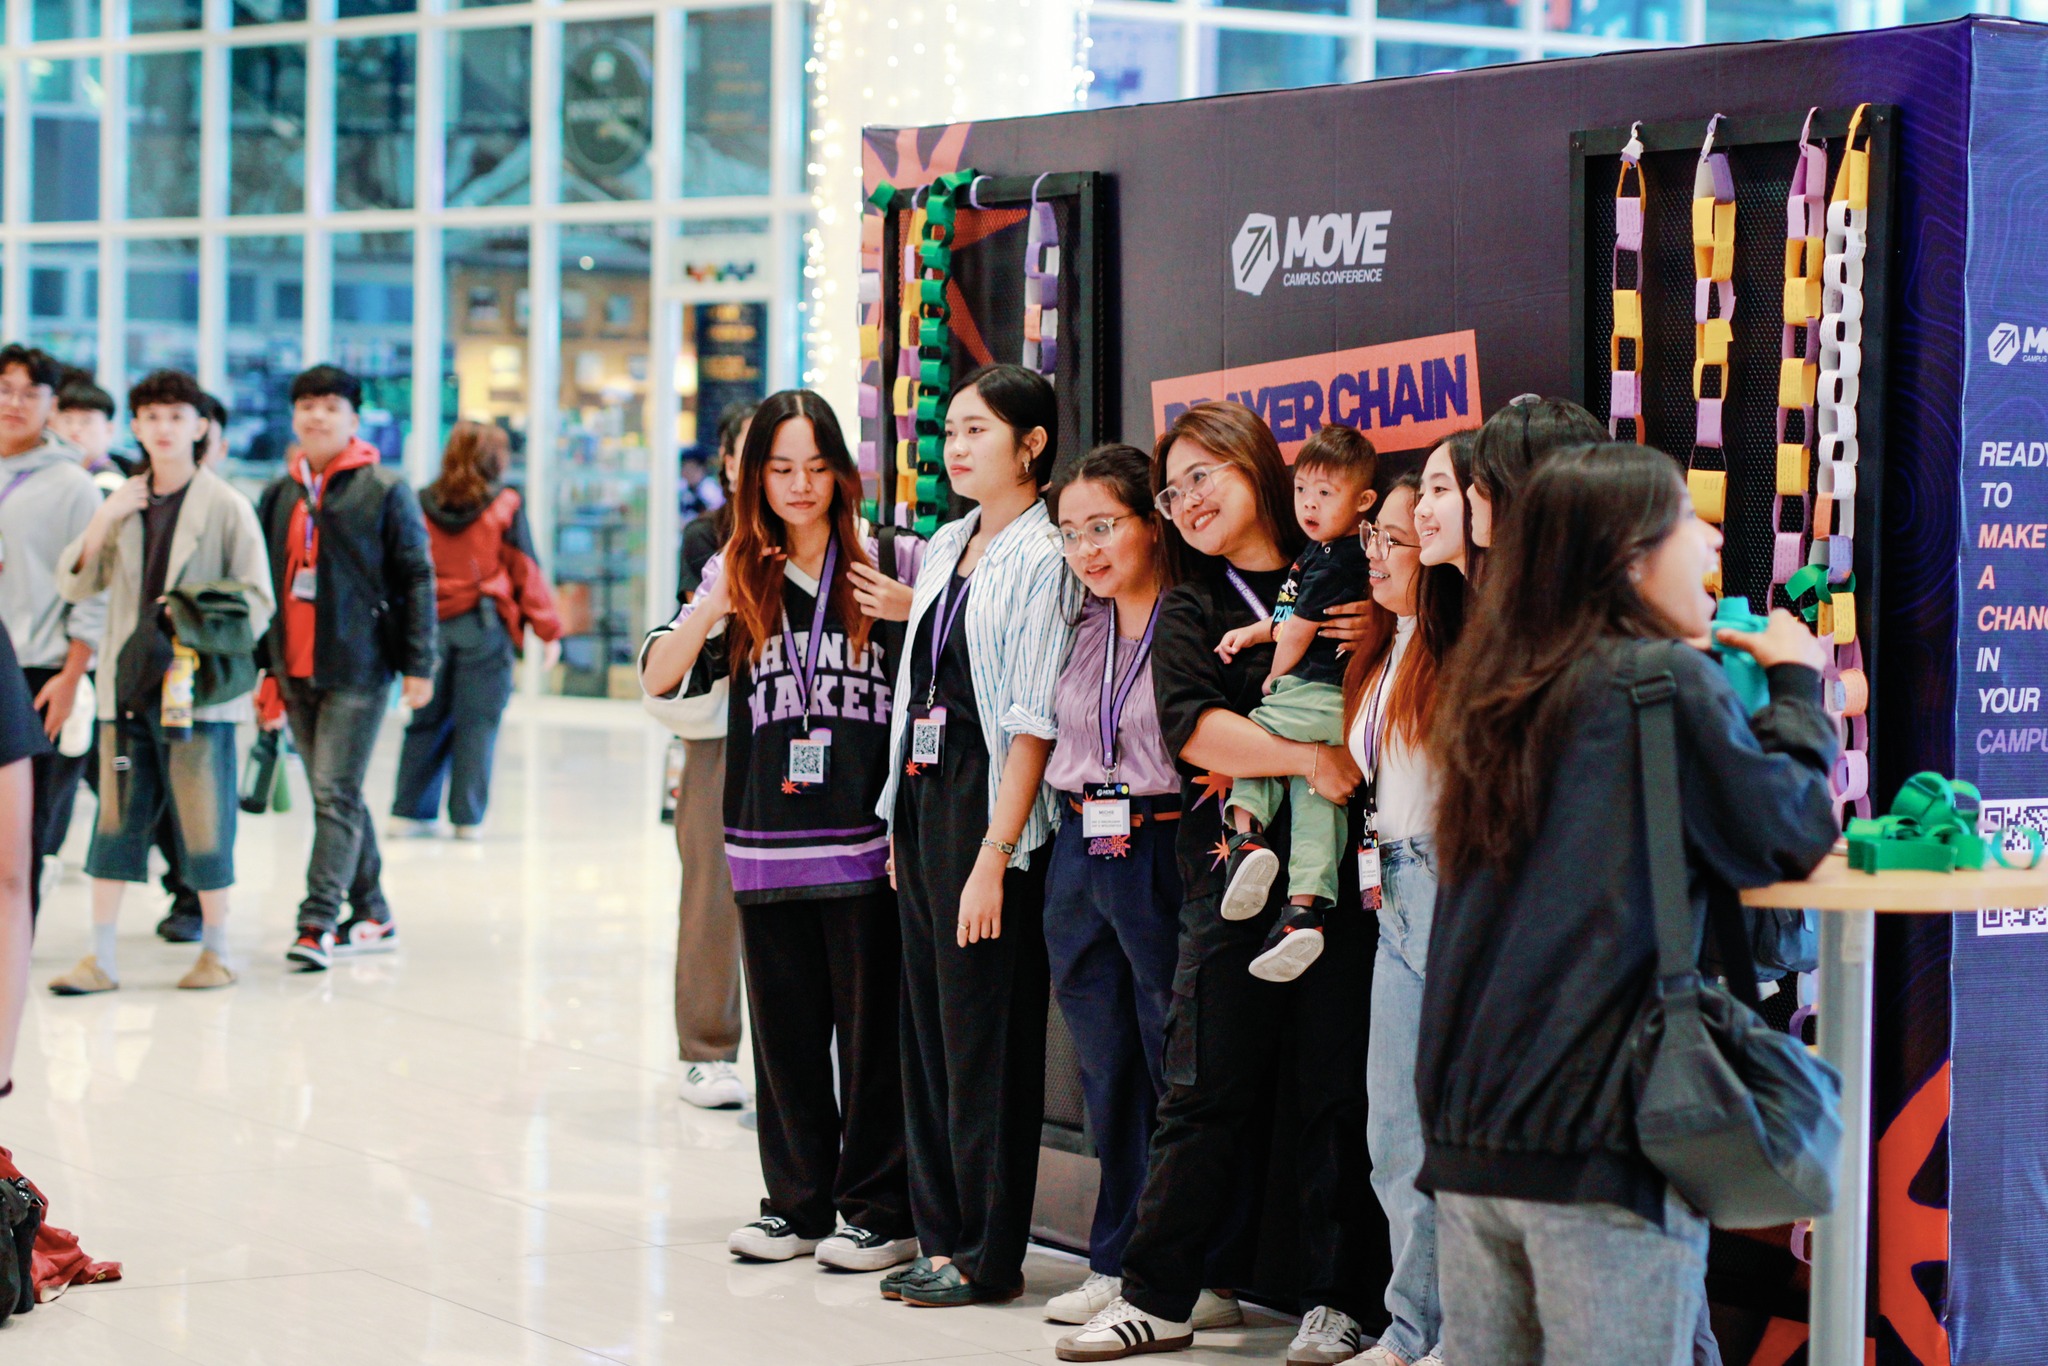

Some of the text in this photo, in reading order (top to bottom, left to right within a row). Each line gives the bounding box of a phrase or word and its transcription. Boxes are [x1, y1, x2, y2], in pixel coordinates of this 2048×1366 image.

[1282, 210, 1392, 269] MOVE
[1283, 268, 1383, 287] CAMPUS CONFERENCE
[2022, 354, 2048, 363] CAMPUS
[1327, 354, 1468, 432] CHAIN
[1979, 441, 2048, 467] READ
[1981, 482, 2013, 508] TO
[1978, 523, 2048, 549] MAKE
[1977, 565, 1996, 590] A
[1977, 605, 2048, 632] CHAN
[1976, 647, 2001, 673] IN
[1978, 687, 2041, 714] YOUR
